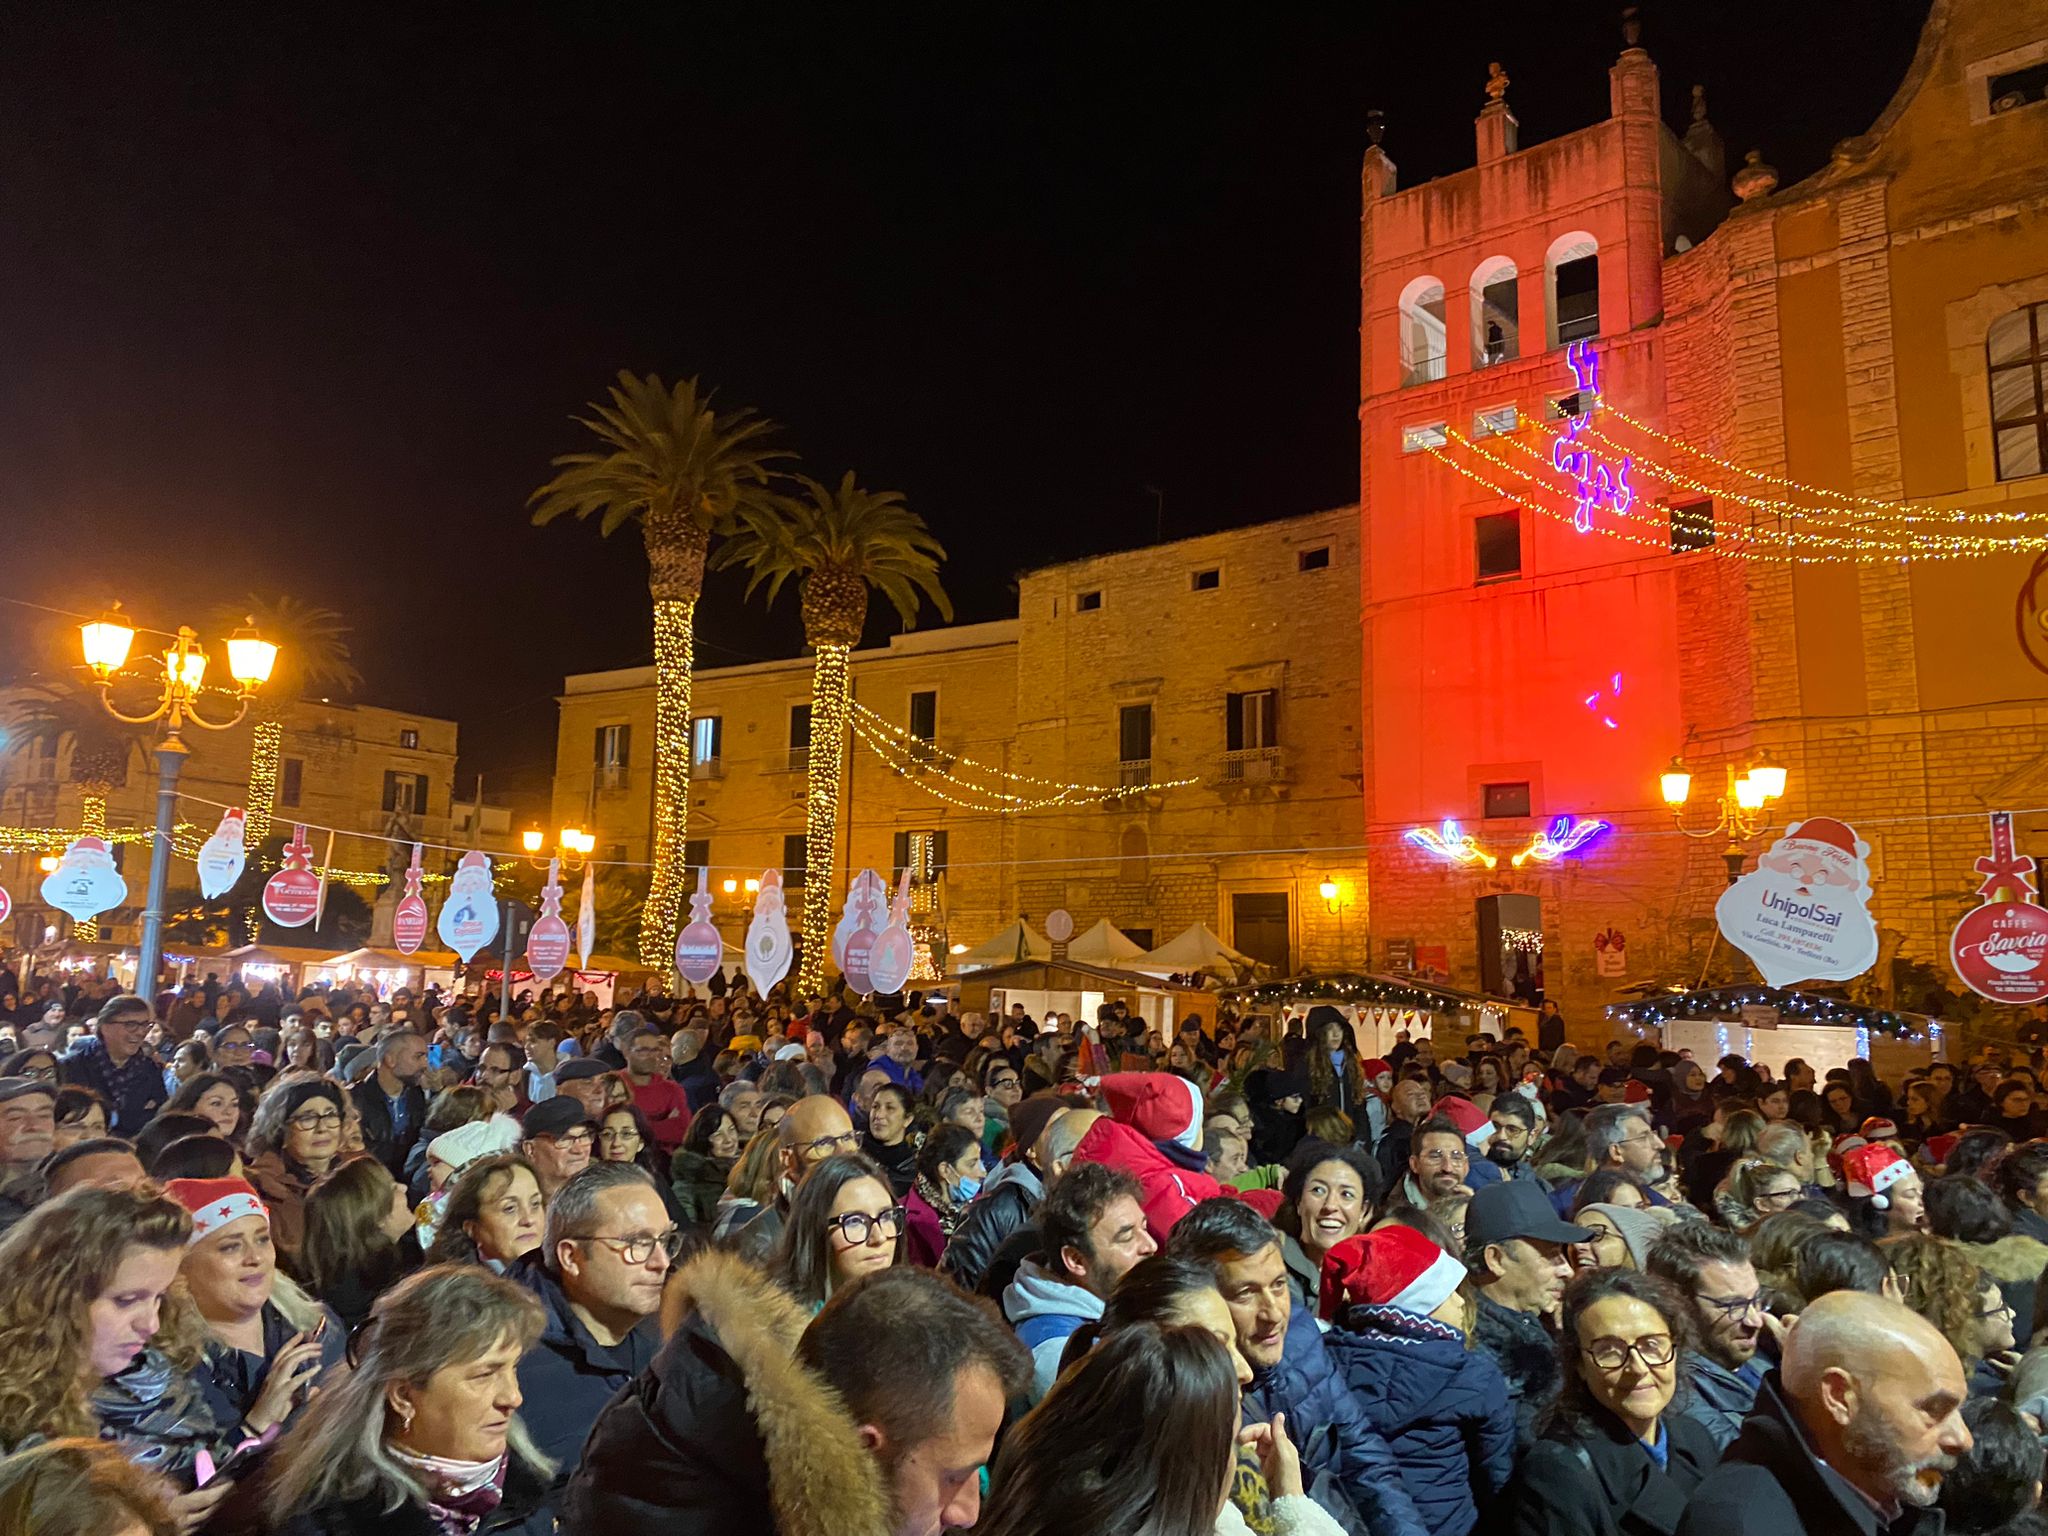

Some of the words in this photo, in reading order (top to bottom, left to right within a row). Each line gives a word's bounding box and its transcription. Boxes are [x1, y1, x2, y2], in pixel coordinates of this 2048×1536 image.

[1762, 889, 1842, 927] UnipolSai
[1756, 913, 1779, 928] Luca
[1781, 920, 1834, 943] Lamparelli
[1959, 931, 2048, 957] Savoia
